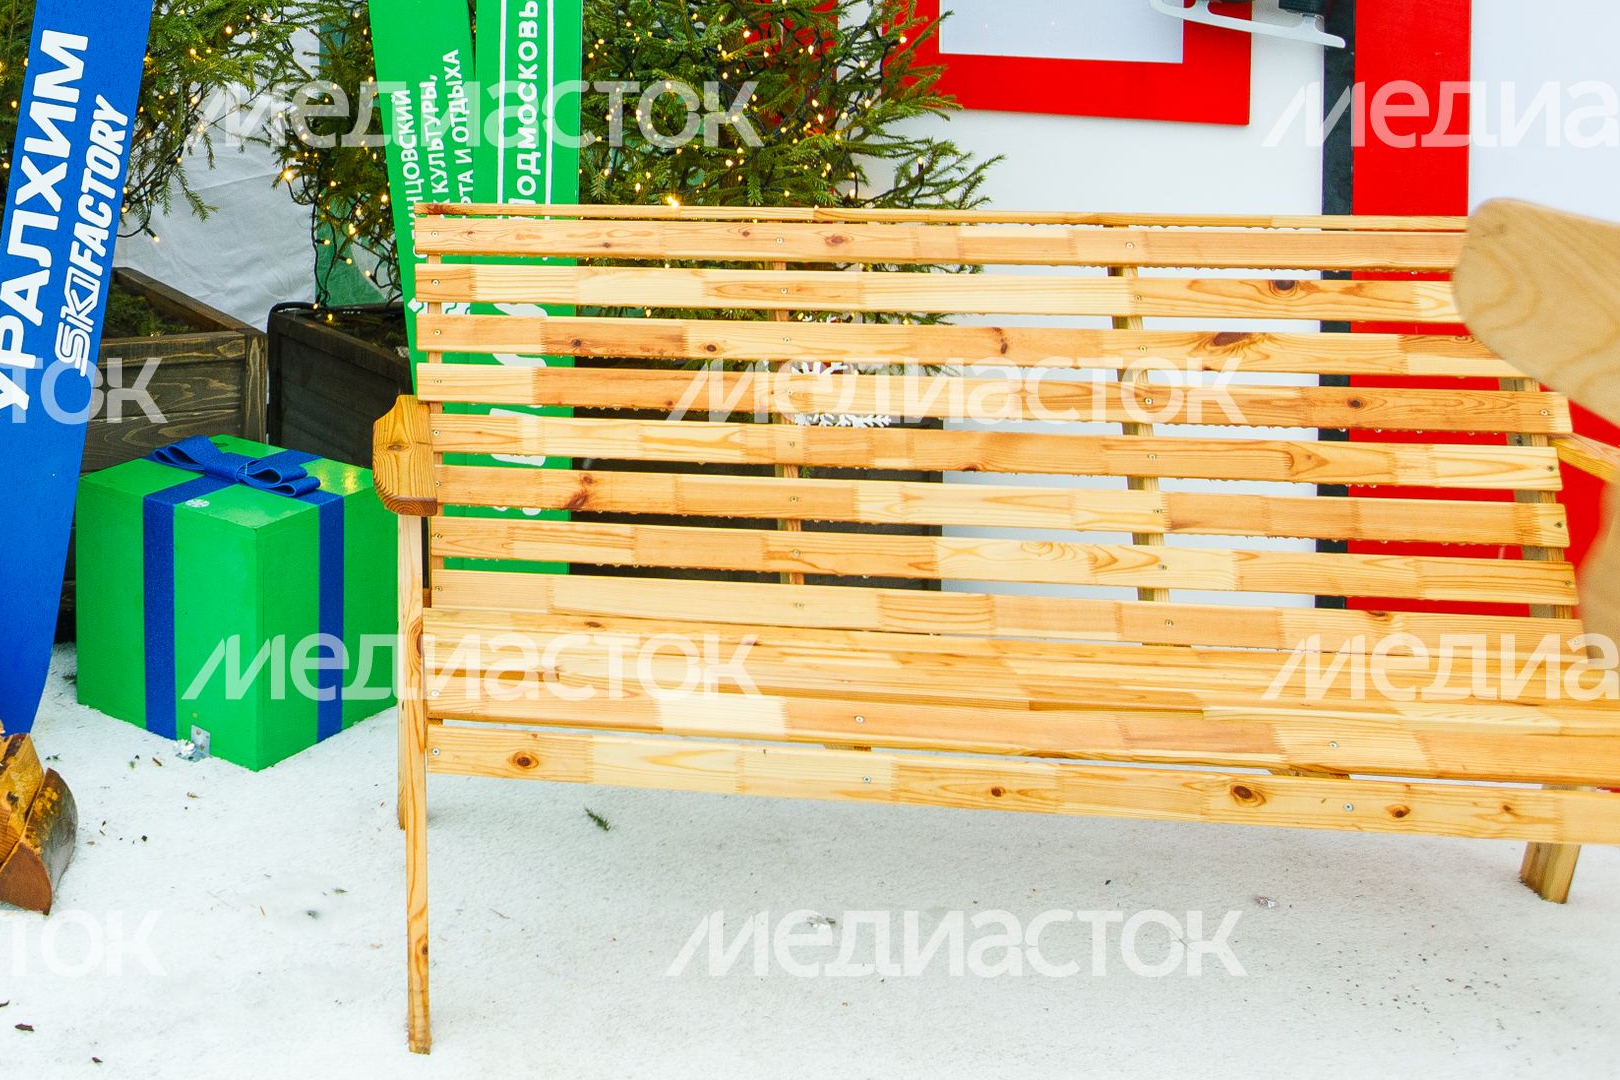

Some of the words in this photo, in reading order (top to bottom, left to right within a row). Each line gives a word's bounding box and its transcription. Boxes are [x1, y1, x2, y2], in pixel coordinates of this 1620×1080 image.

[419, 74, 450, 194] КУЛЬТУРЫ,
[442, 48, 471, 143] ОТДЫХА
[453, 148, 473, 165] И
